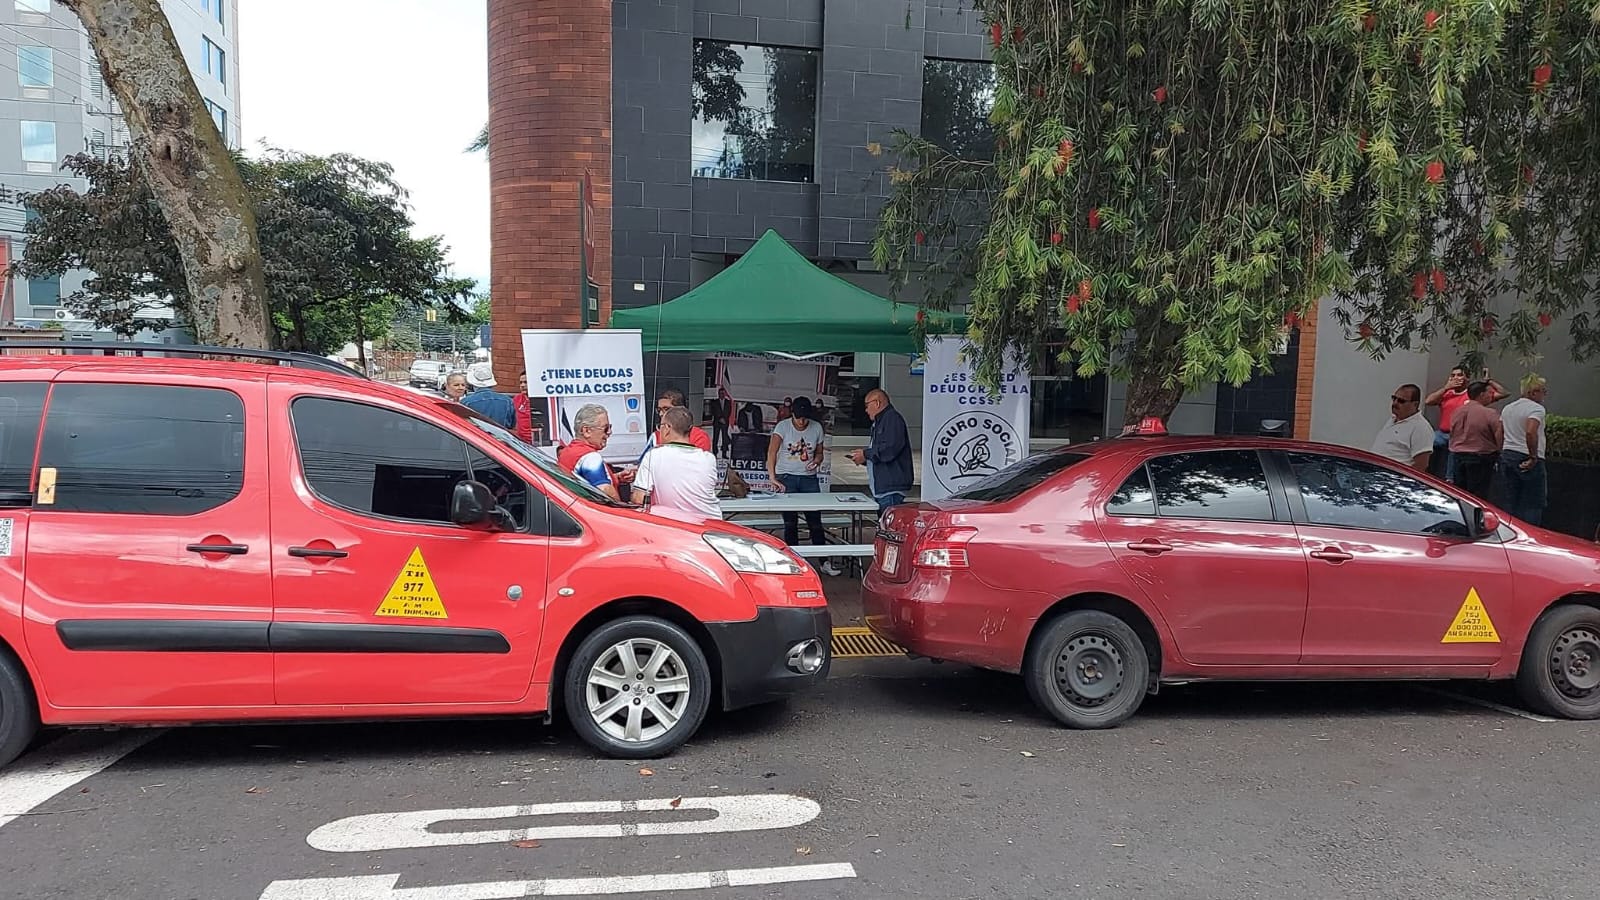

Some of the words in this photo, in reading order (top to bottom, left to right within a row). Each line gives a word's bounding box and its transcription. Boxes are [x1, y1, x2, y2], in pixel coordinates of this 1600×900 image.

[541, 368, 582, 382] ¿TIENE
[584, 368, 633, 379] DEUDAS
[944, 373, 967, 384] ¿ES
[545, 384, 574, 394] CON
[576, 384, 592, 394] LA
[593, 382, 633, 393] CCSS?
[930, 384, 986, 394] DEUDOR
[1012, 385, 1029, 394] LA
[937, 417, 978, 466] SEGURO
[982, 418, 1017, 466] SOCIAL
[730, 460, 748, 469] LEY
[750, 460, 763, 470] DE
[403, 582, 424, 592] 977
